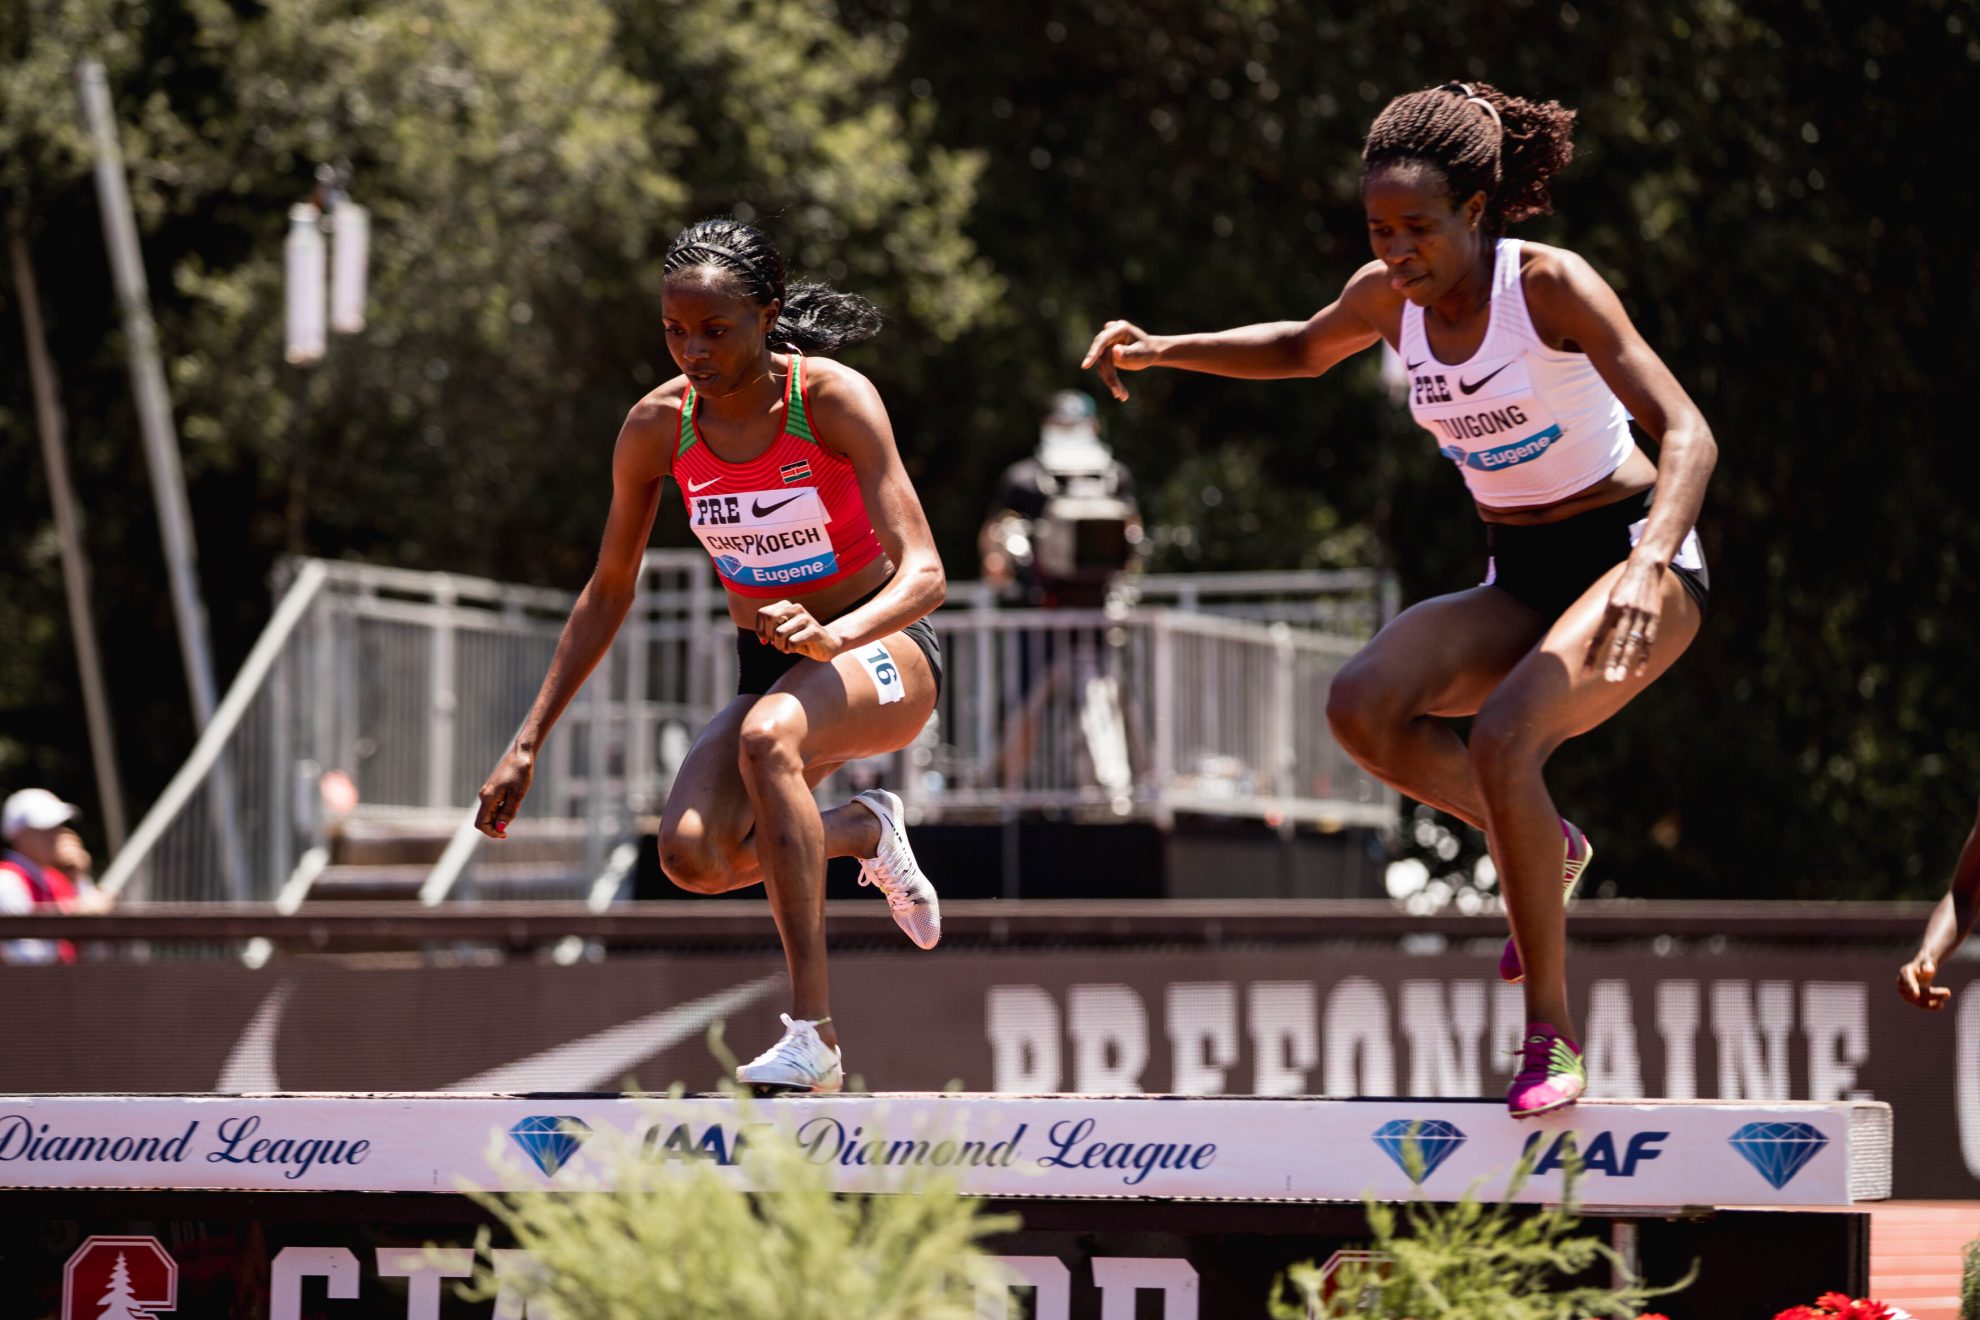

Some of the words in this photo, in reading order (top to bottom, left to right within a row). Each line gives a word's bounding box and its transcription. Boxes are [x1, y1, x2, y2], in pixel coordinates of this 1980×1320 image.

[1415, 375, 1452, 404] PRE
[1433, 405, 1528, 440] TUIGONG
[1478, 436, 1550, 467] Eugene
[697, 497, 741, 525] PRE
[706, 527, 821, 556] CHEPKOECH
[752, 561, 825, 583] Eugene
[867, 648, 898, 685] 16
[0, 1115, 199, 1162] Diamond
[206, 1115, 371, 1180] League
[795, 1116, 1028, 1169] Diamond
[1036, 1118, 1218, 1185] League
[1522, 1130, 1671, 1176] IAAF
